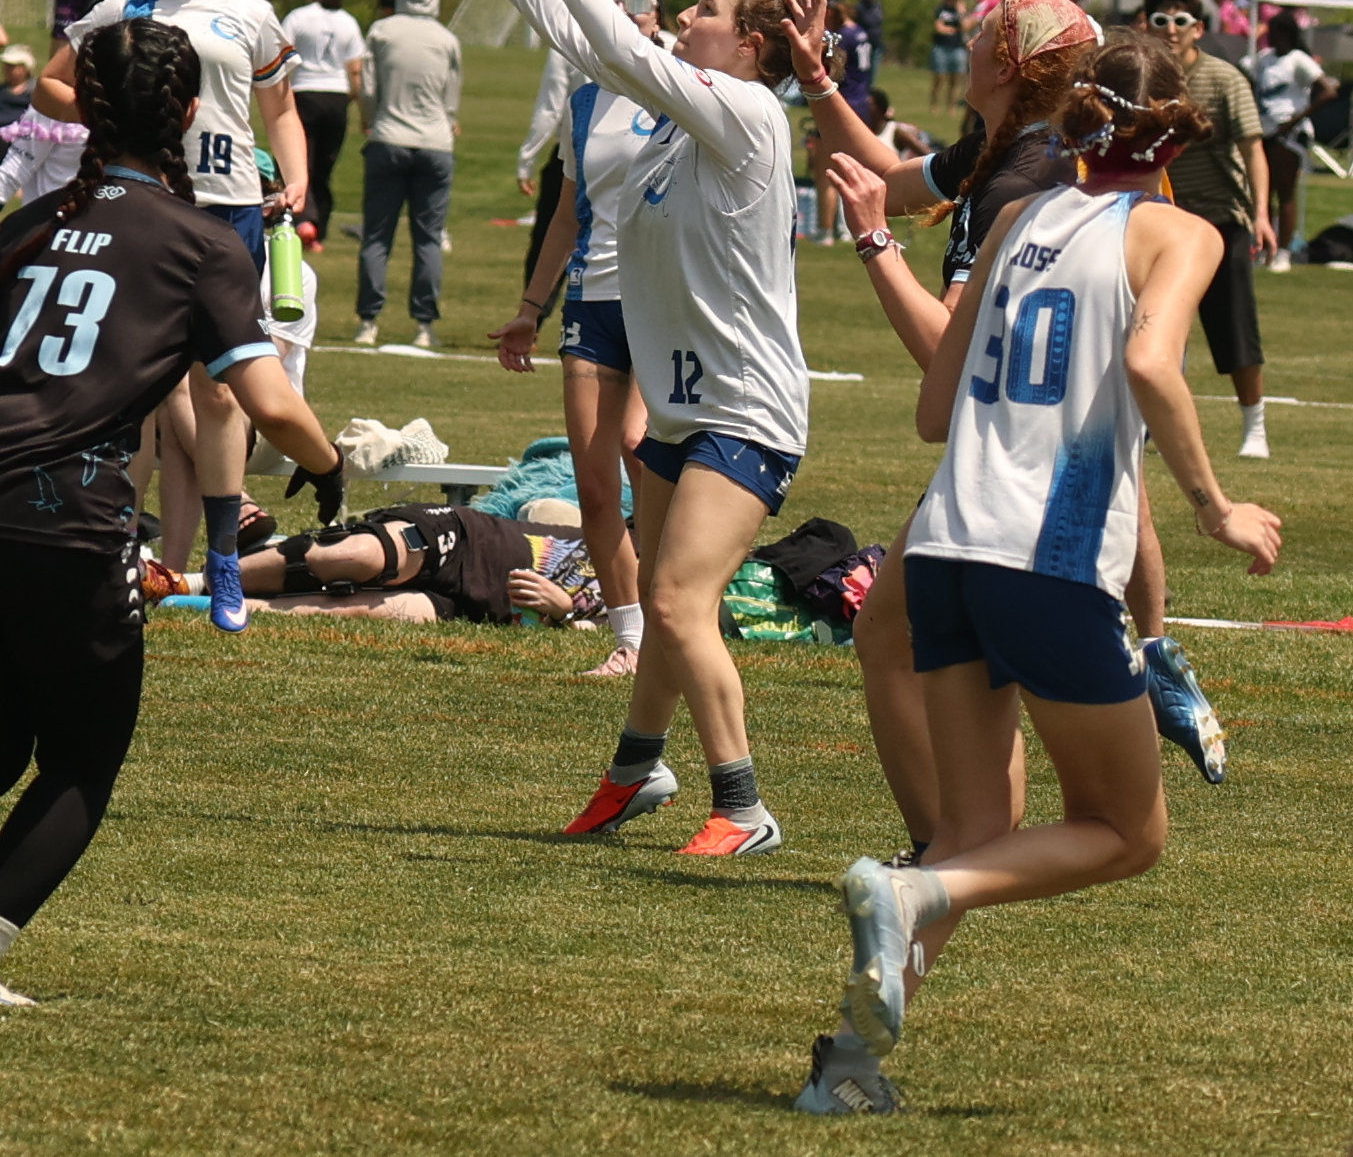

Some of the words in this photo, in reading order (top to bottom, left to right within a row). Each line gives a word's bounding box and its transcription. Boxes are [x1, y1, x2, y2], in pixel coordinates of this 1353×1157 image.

[196, 131, 233, 175] 19
[50, 228, 113, 256] FLIP
[967, 284, 1076, 406] 30
[667, 349, 704, 405] 12
